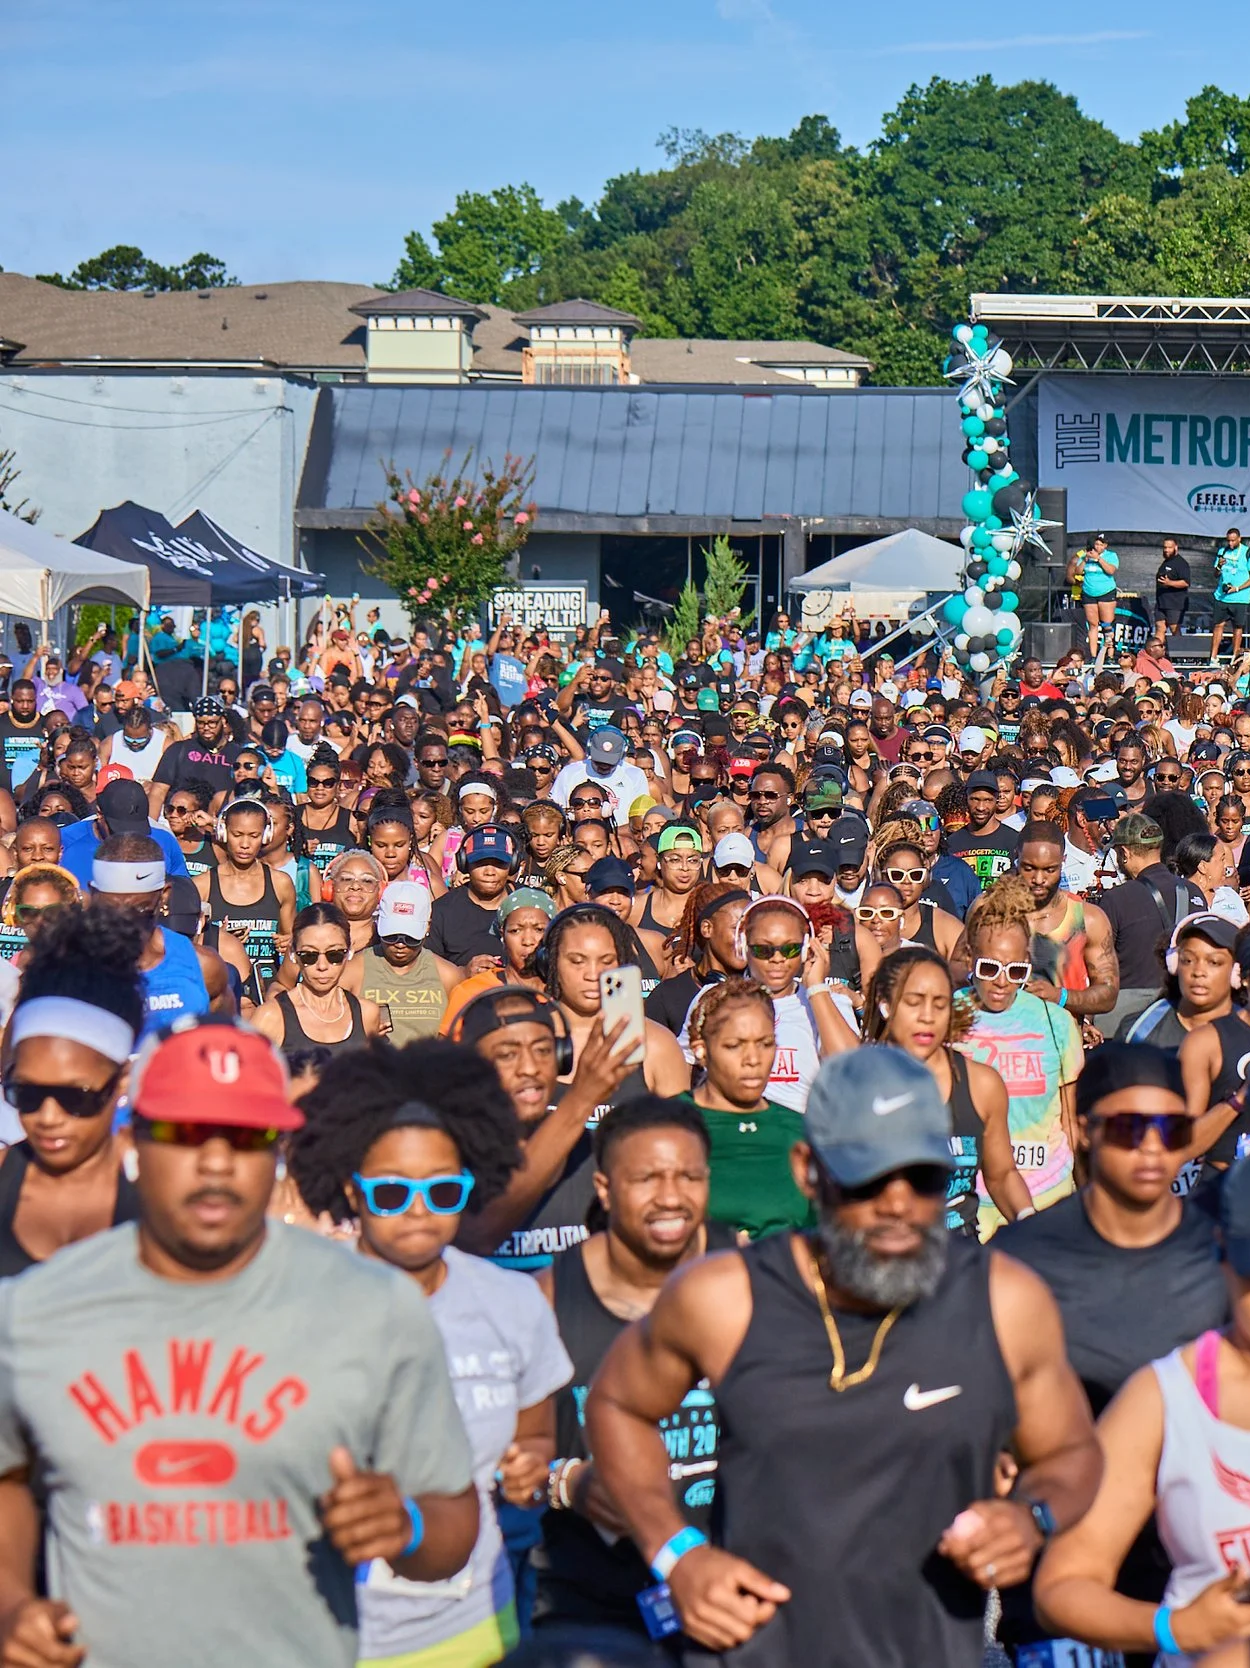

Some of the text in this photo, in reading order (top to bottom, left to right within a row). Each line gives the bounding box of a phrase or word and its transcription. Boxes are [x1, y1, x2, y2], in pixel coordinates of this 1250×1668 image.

[1056, 413, 1100, 469] THE
[494, 592, 581, 610] SPREADING
[495, 610, 580, 626] TE HEALTH
[227, 919, 272, 932] ETROPOLITAN
[405, 990, 442, 1004] SZN
[1000, 1054, 1045, 1078] HEAL
[67, 1337, 309, 1446] HAWKS
[107, 1499, 293, 1547] BASKETBALL
